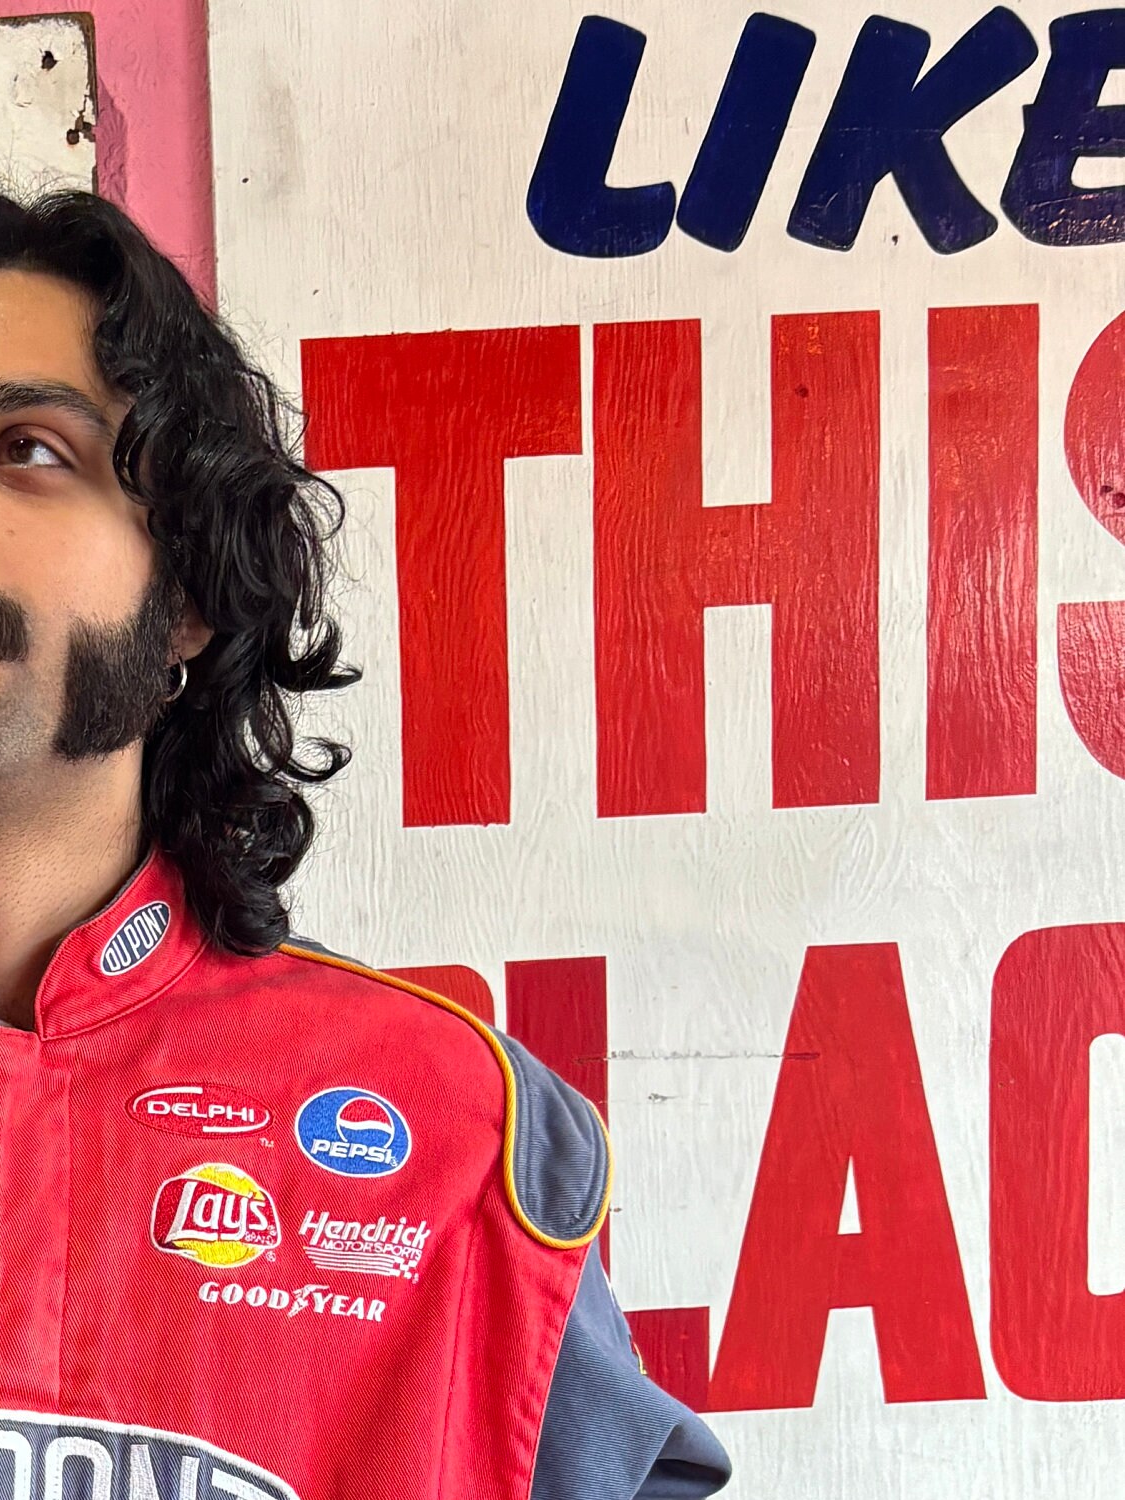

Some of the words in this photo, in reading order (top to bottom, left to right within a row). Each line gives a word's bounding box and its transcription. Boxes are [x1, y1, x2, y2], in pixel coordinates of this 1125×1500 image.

[526, 5, 1125, 258] LIKE
[147, 1100, 255, 1123] DELPHI
[311, 1138, 393, 1165] PEPSI
[165, 1181, 268, 1243] Lay's
[298, 1209, 431, 1250] Hendrick
[321, 1238, 423, 1261] MOTORSPORTS
